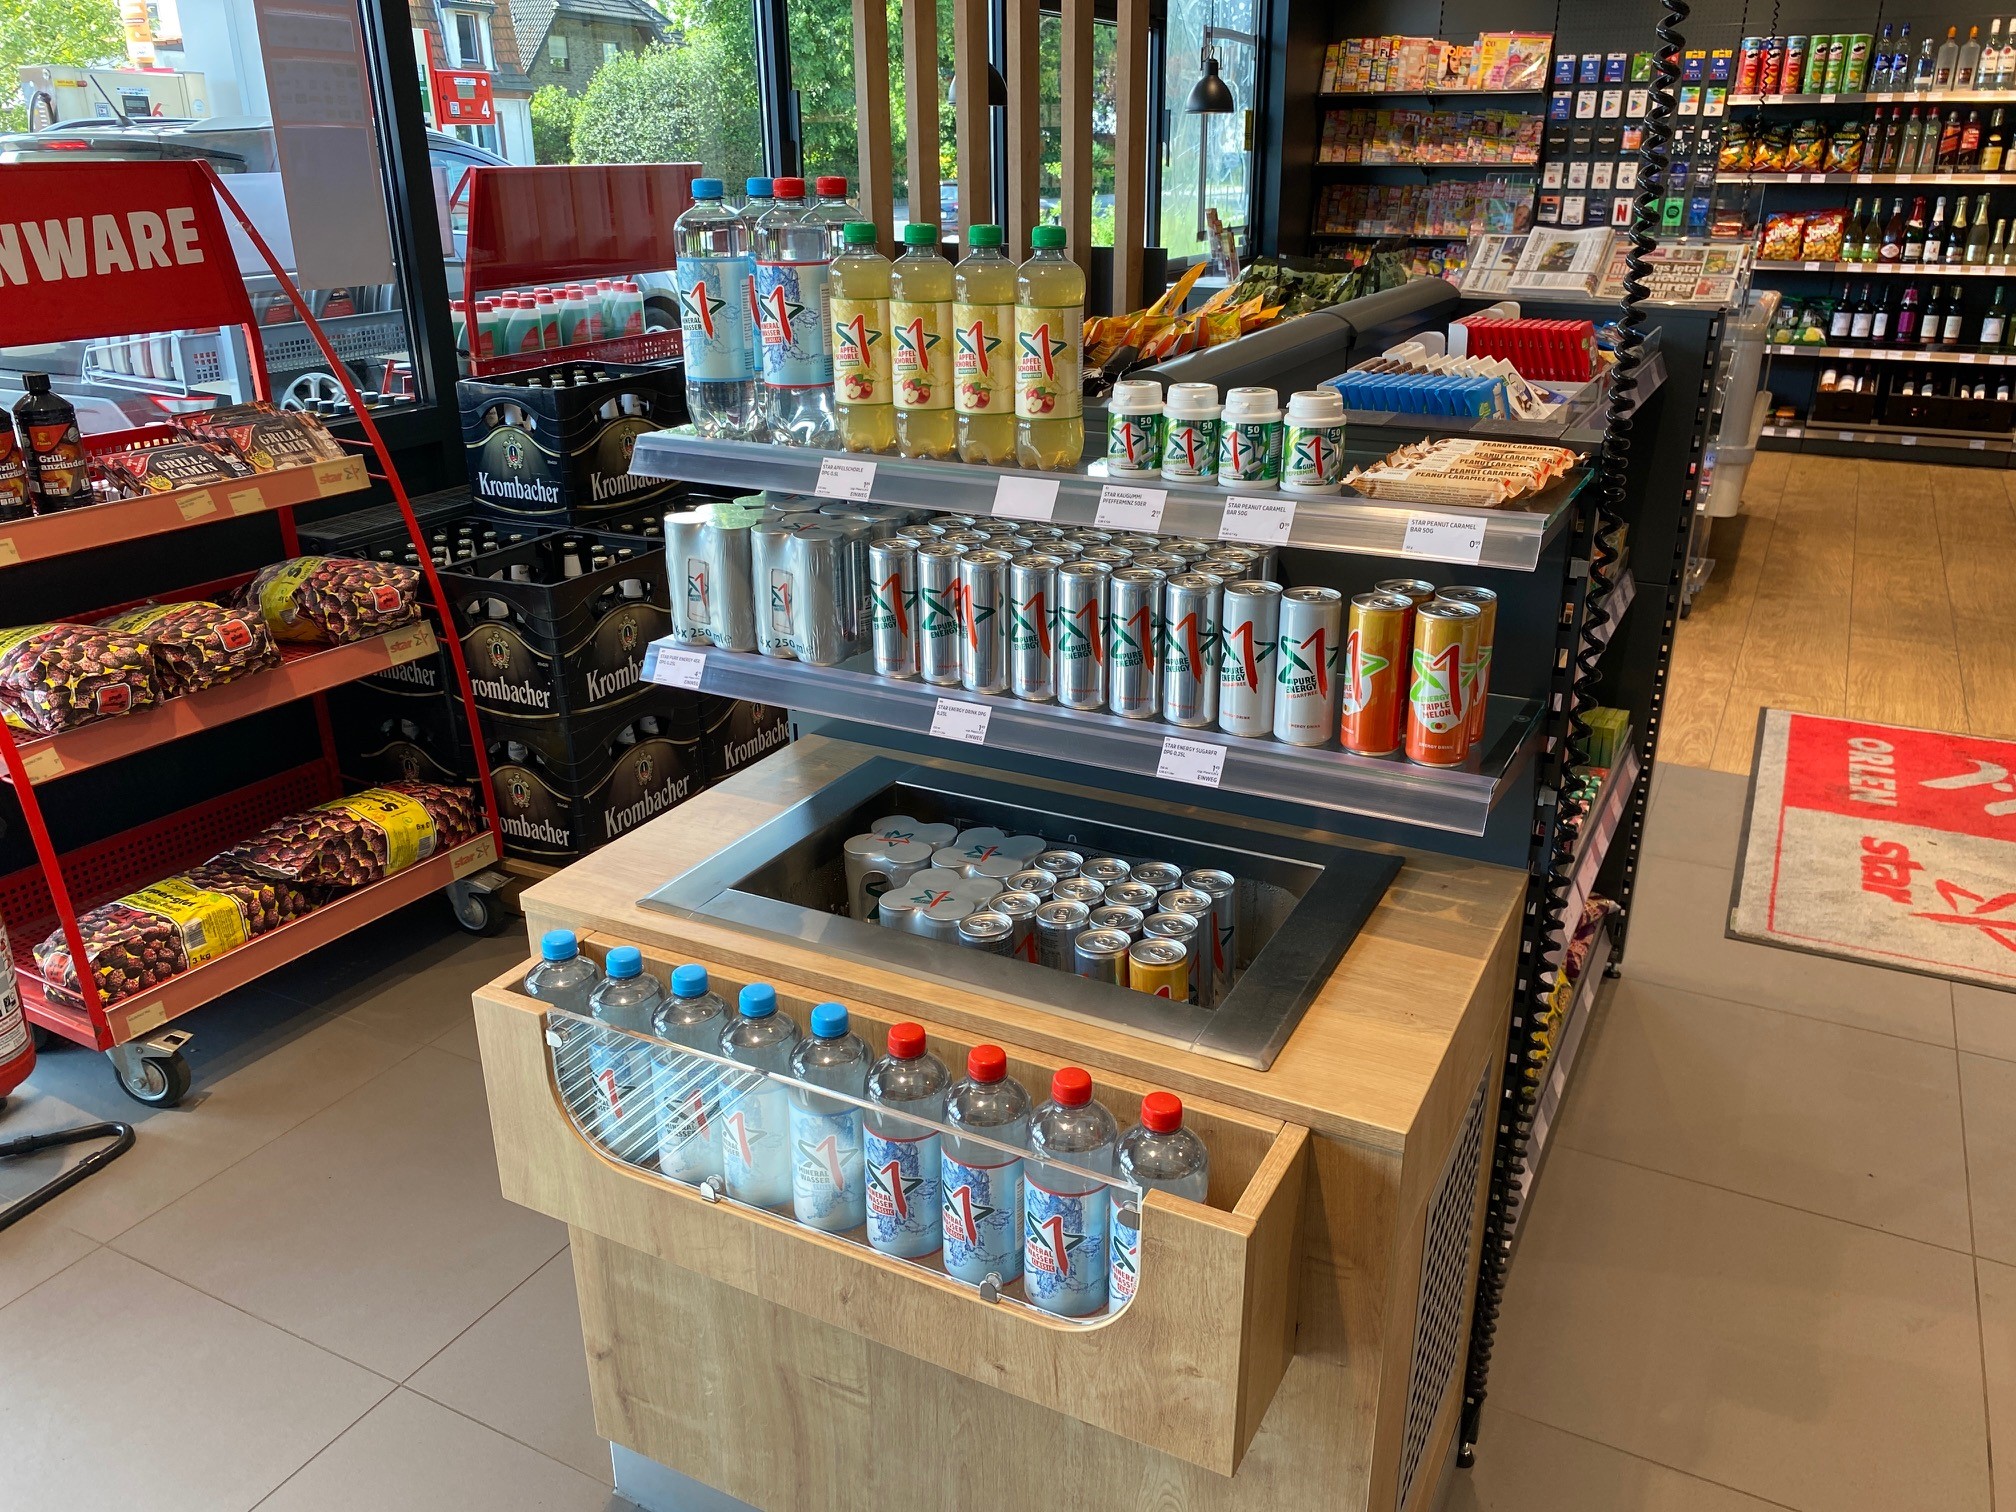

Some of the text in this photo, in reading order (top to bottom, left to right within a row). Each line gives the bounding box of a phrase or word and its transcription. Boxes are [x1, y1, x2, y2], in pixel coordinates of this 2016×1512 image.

[152, 102, 163, 117] 6
[481, 100, 490, 118] 4
[840, 346, 859, 354] APFEL
[955, 360, 977, 368] SCHORLE
[1140, 416, 1152, 425] 50
[1202, 421, 1213, 430] 50
[1247, 425, 1260, 434] 50
[1331, 428, 1341, 437] 50
[258, 429, 296, 446] GRILL
[265, 438, 314, 456] KAMIN
[1482, 441, 1511, 449] PEANUT
[39, 454, 67, 463] Grill-
[1474, 451, 1504, 459] PEANUT
[1505, 453, 1540, 461] CARAMEL
[0, 462, 18, 472] rill-
[41, 459, 85, 471] anzünder
[155, 456, 199, 471] GRILL
[1302, 462, 1316, 470] GUM
[1459, 458, 1490, 467] PEANUT
[163, 462, 219, 480] KAMIN
[1415, 471, 1486, 482] PEANUT CARAMEL
[1450, 467, 1481, 475] PEANUT
[1483, 469, 1520, 477] CARAMEL
[319, 470, 344, 486] star
[478, 471, 560, 504] Krombacher
[1117, 492, 1143, 500] KAUGUMMI
[1102, 498, 1134, 506] PFEFFERMINZ
[1241, 503, 1262, 511] PEANUT
[1262, 505, 1287, 513] CARAMEL
[1426, 520, 1450, 528] PEANUT
[1449, 522, 1477, 531] CARAMEL
[878, 614, 895, 623] PURE
[874, 621, 897, 630] ENERGY
[937, 620, 957, 631] PURE
[690, 627, 713, 638] 250
[930, 628, 958, 639] ENERGY
[774, 637, 796, 649] 250
[1020, 634, 1039, 643] PURE
[390, 639, 413, 653] star
[1014, 641, 1040, 651] ENERGY
[1071, 642, 1092, 651] PURE
[1065, 649, 1093, 659] ENERGY
[1122, 651, 1144, 660] PURE
[1116, 657, 1145, 668] ENERGY
[1170, 656, 1190, 666] PURE
[1165, 664, 1190, 673] ENERGY
[1225, 666, 1246, 676] PURE
[1221, 673, 1246, 682] ENERGY
[1293, 675, 1317, 685] PURE
[470, 675, 551, 709] rombacher
[1285, 683, 1318, 694] ENERGY
[1417, 693, 1450, 703] ENERGY
[1421, 701, 1450, 712] TRIPLE
[1422, 709, 1451, 719] MELON
[723, 716, 791, 771] Krombache
[1164, 742, 1218, 756] STAR ENERGY SUGARFR
[1847, 736, 1898, 808] ORLEN
[1197, 774, 1218, 783] EINWEG
[604, 772, 690, 840] Krombacher
[481, 806, 571, 848] Kombacher
[453, 854, 476, 870] star
[1860, 835, 1925, 906] star
[192, 952, 212, 965] 3 kg
[799, 1167, 830, 1178] MINERAL
[800, 1174, 831, 1184] WASSER
[868, 1186, 893, 1202] MINERAL
[869, 1196, 893, 1210] WASSER
[1026, 1240, 1054, 1258] MINERAL
[1027, 1251, 1055, 1267] WASSER
